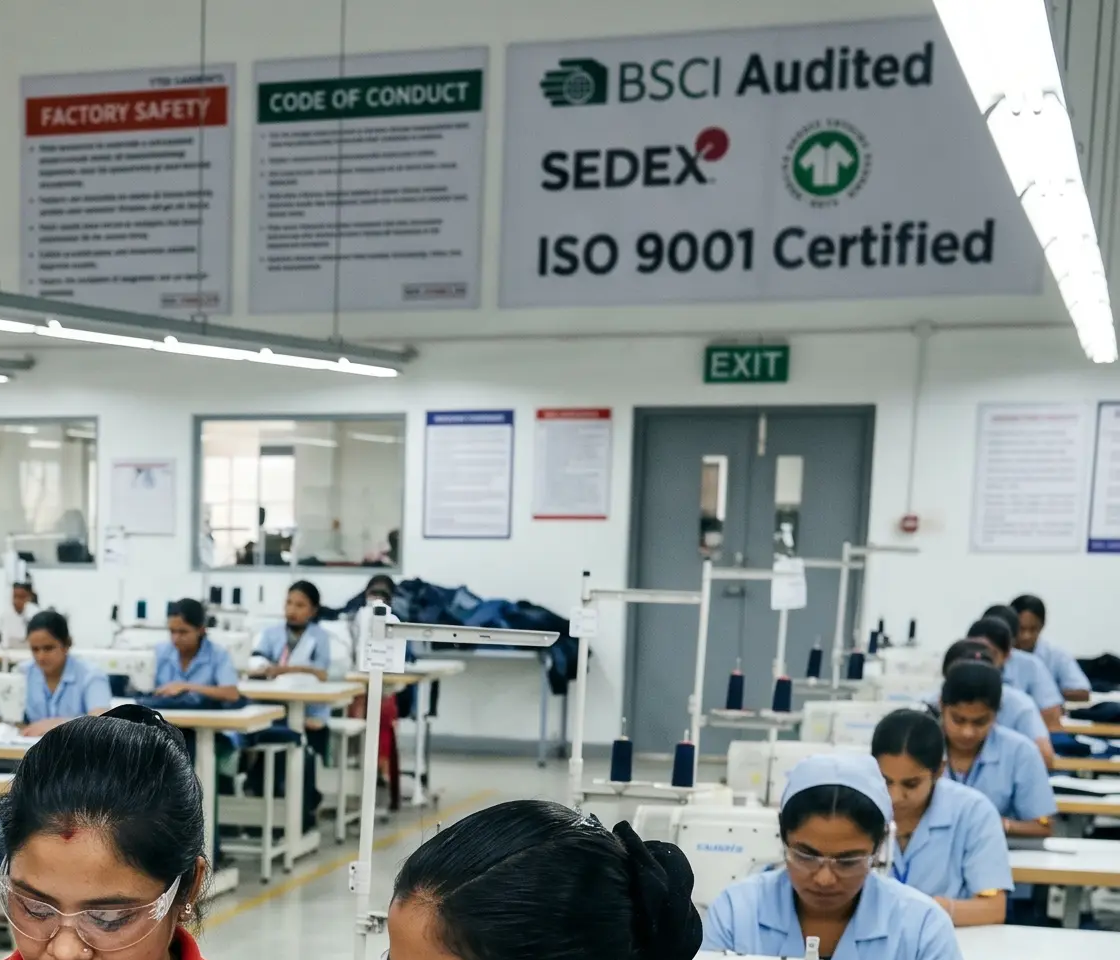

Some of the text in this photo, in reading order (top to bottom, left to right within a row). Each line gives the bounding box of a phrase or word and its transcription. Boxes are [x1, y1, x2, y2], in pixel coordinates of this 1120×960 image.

[618, 41, 935, 103] BSCI Audited
[40, 97, 211, 127] FACTORY SAFETY
[269, 82, 470, 113] CODE OF CONDUCT
[541, 145, 708, 191] SEDEX
[538, 218, 996, 277] ISO 9001 Certified
[710, 350, 784, 379] EXIT
